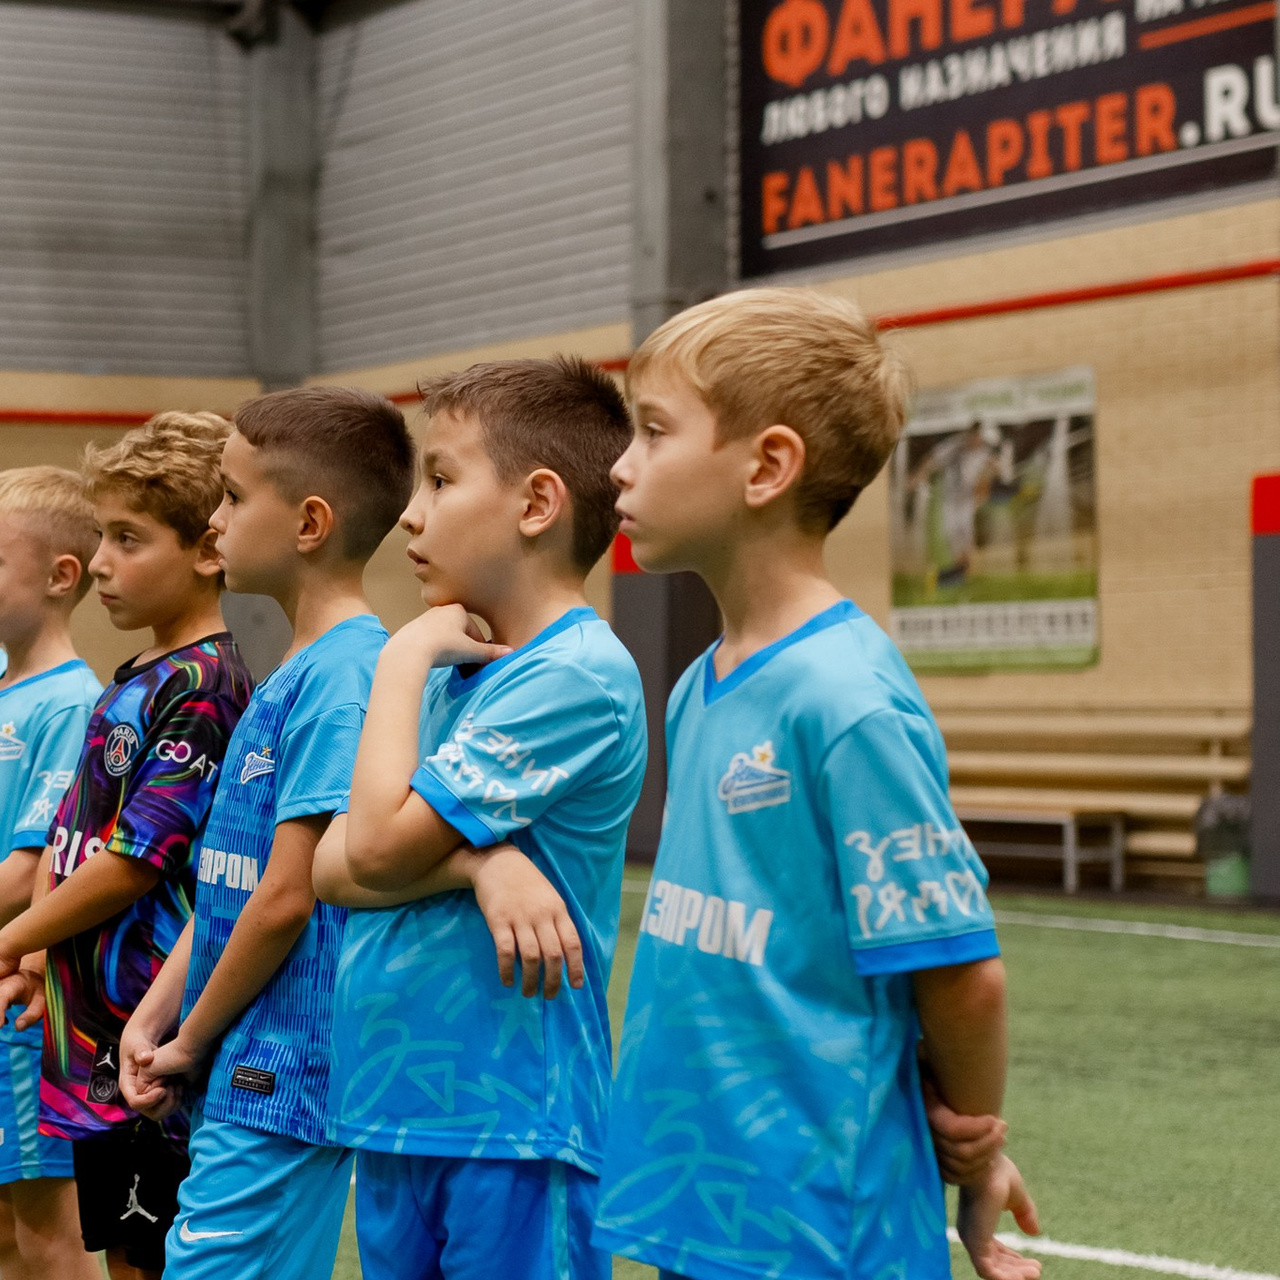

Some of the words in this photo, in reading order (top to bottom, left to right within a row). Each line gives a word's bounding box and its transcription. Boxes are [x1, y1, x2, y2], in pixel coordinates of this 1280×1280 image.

[761, 73, 890, 146] ЛЮБОГО
[899, 10, 1126, 111] НАЗНАЧЕНИЯ
[762, 54, 1280, 236] FANERAPITER.RU
[640, 879, 773, 967] ЗПРОМ
